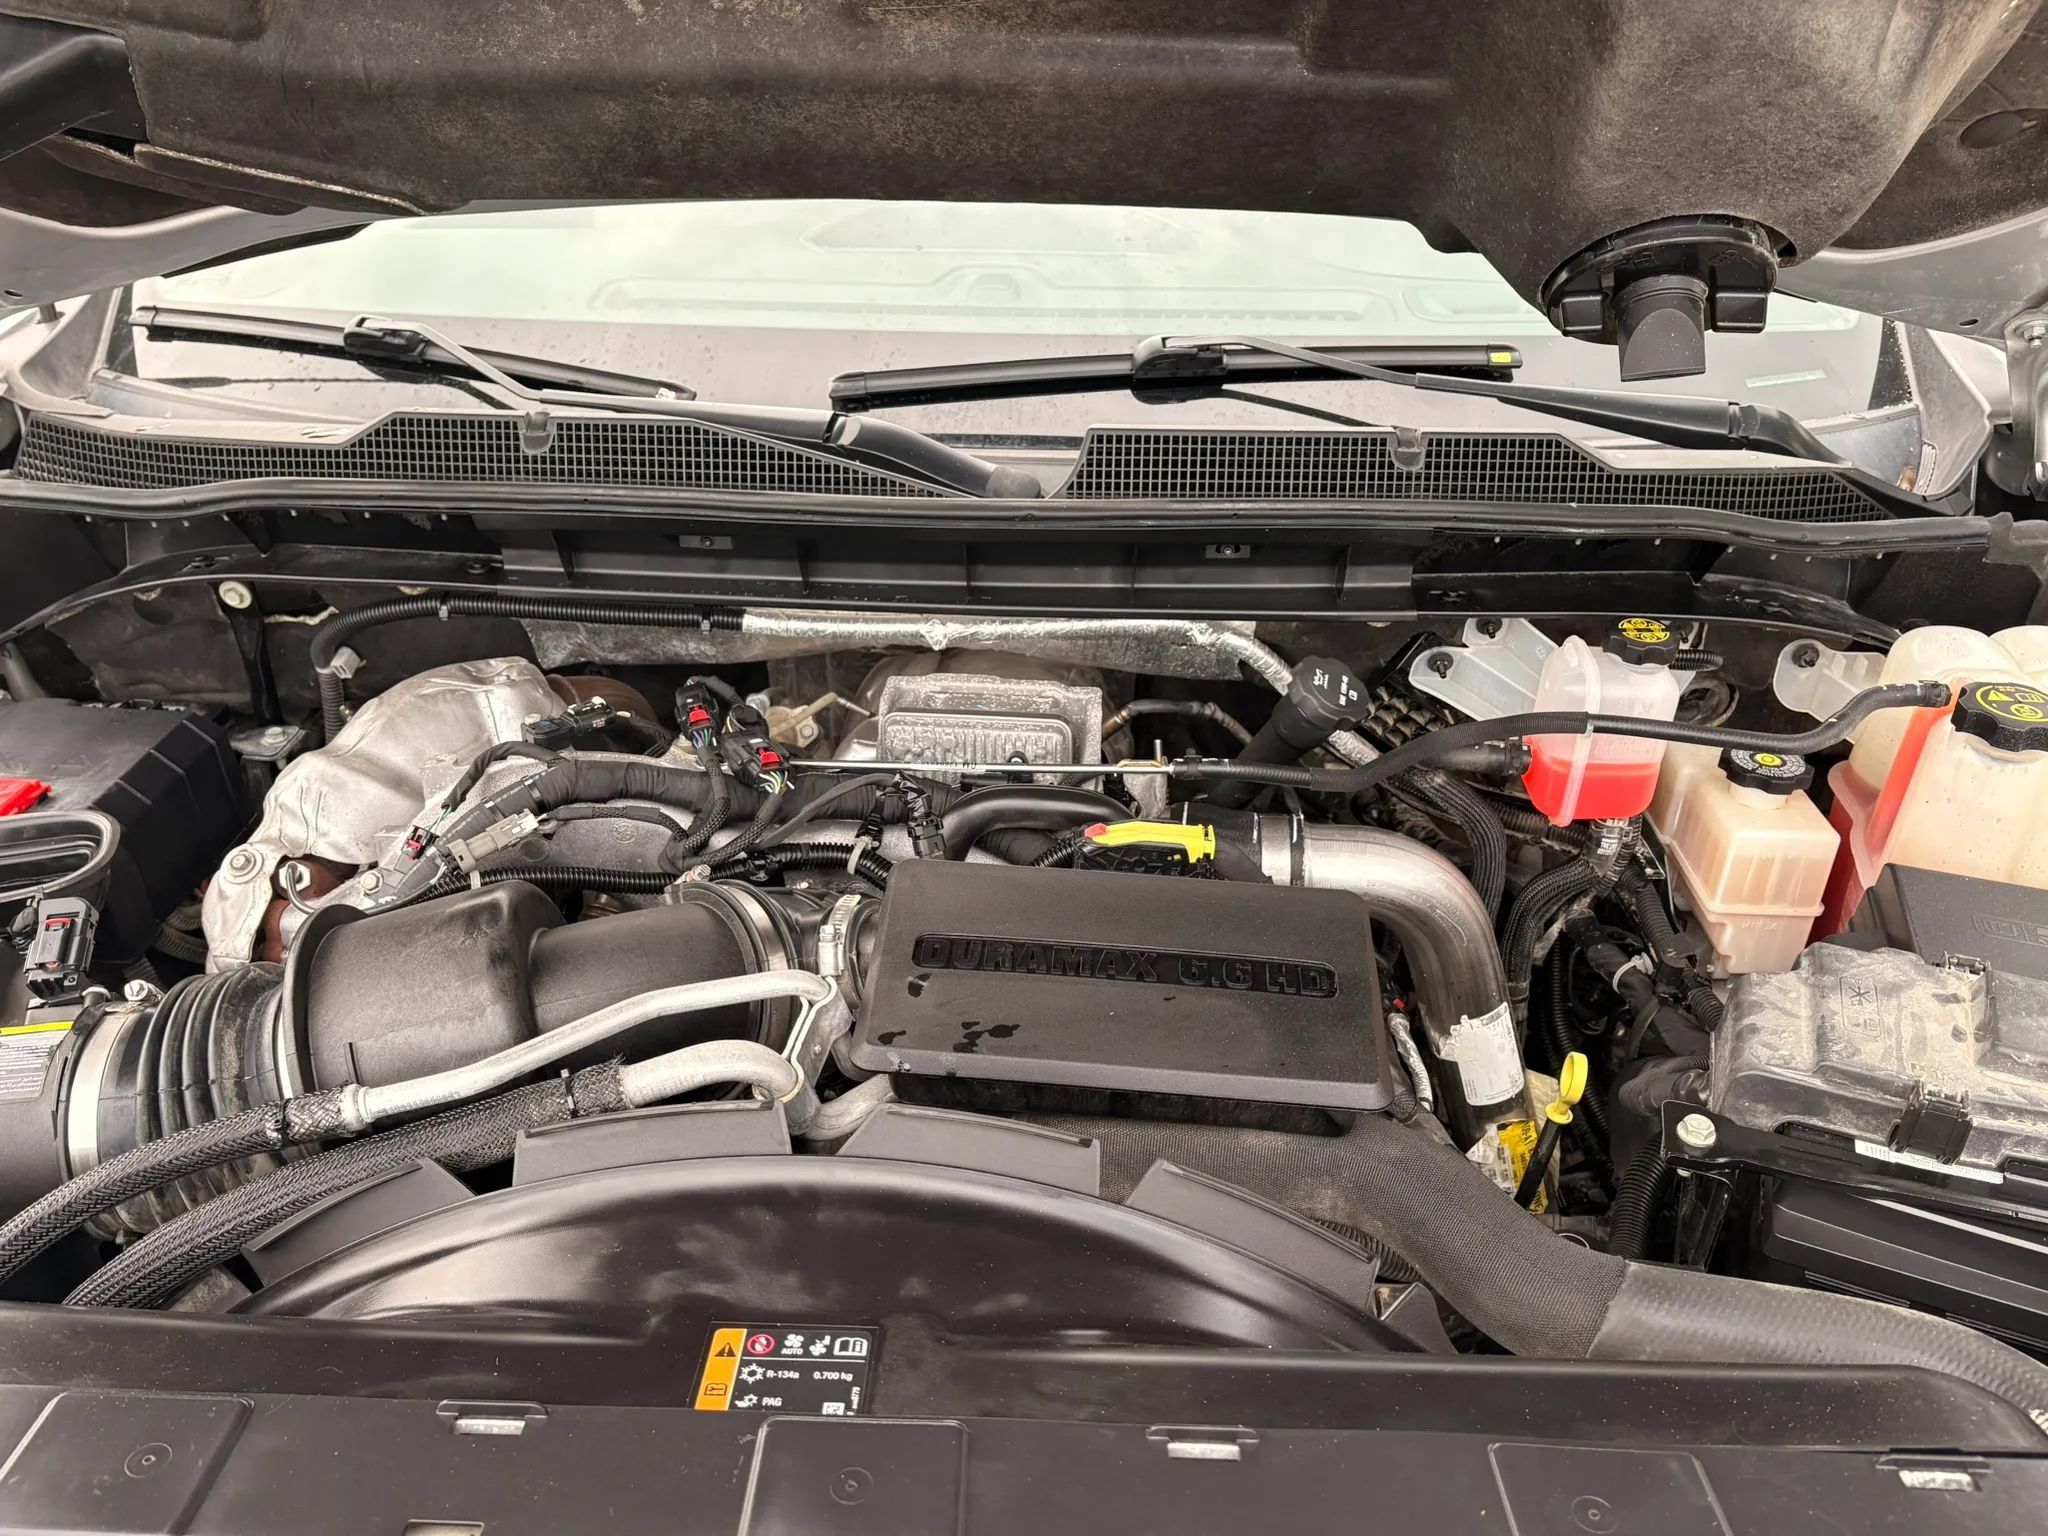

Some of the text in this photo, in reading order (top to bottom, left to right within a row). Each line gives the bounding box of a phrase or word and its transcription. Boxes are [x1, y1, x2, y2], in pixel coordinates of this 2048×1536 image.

[921, 939, 1330, 998] DURAMAX 6.6 HD
[781, 1347, 804, 1355] AUTO
[766, 1369, 853, 1382] R-134a 0.700 kg
[762, 1396, 783, 1407] PAG
